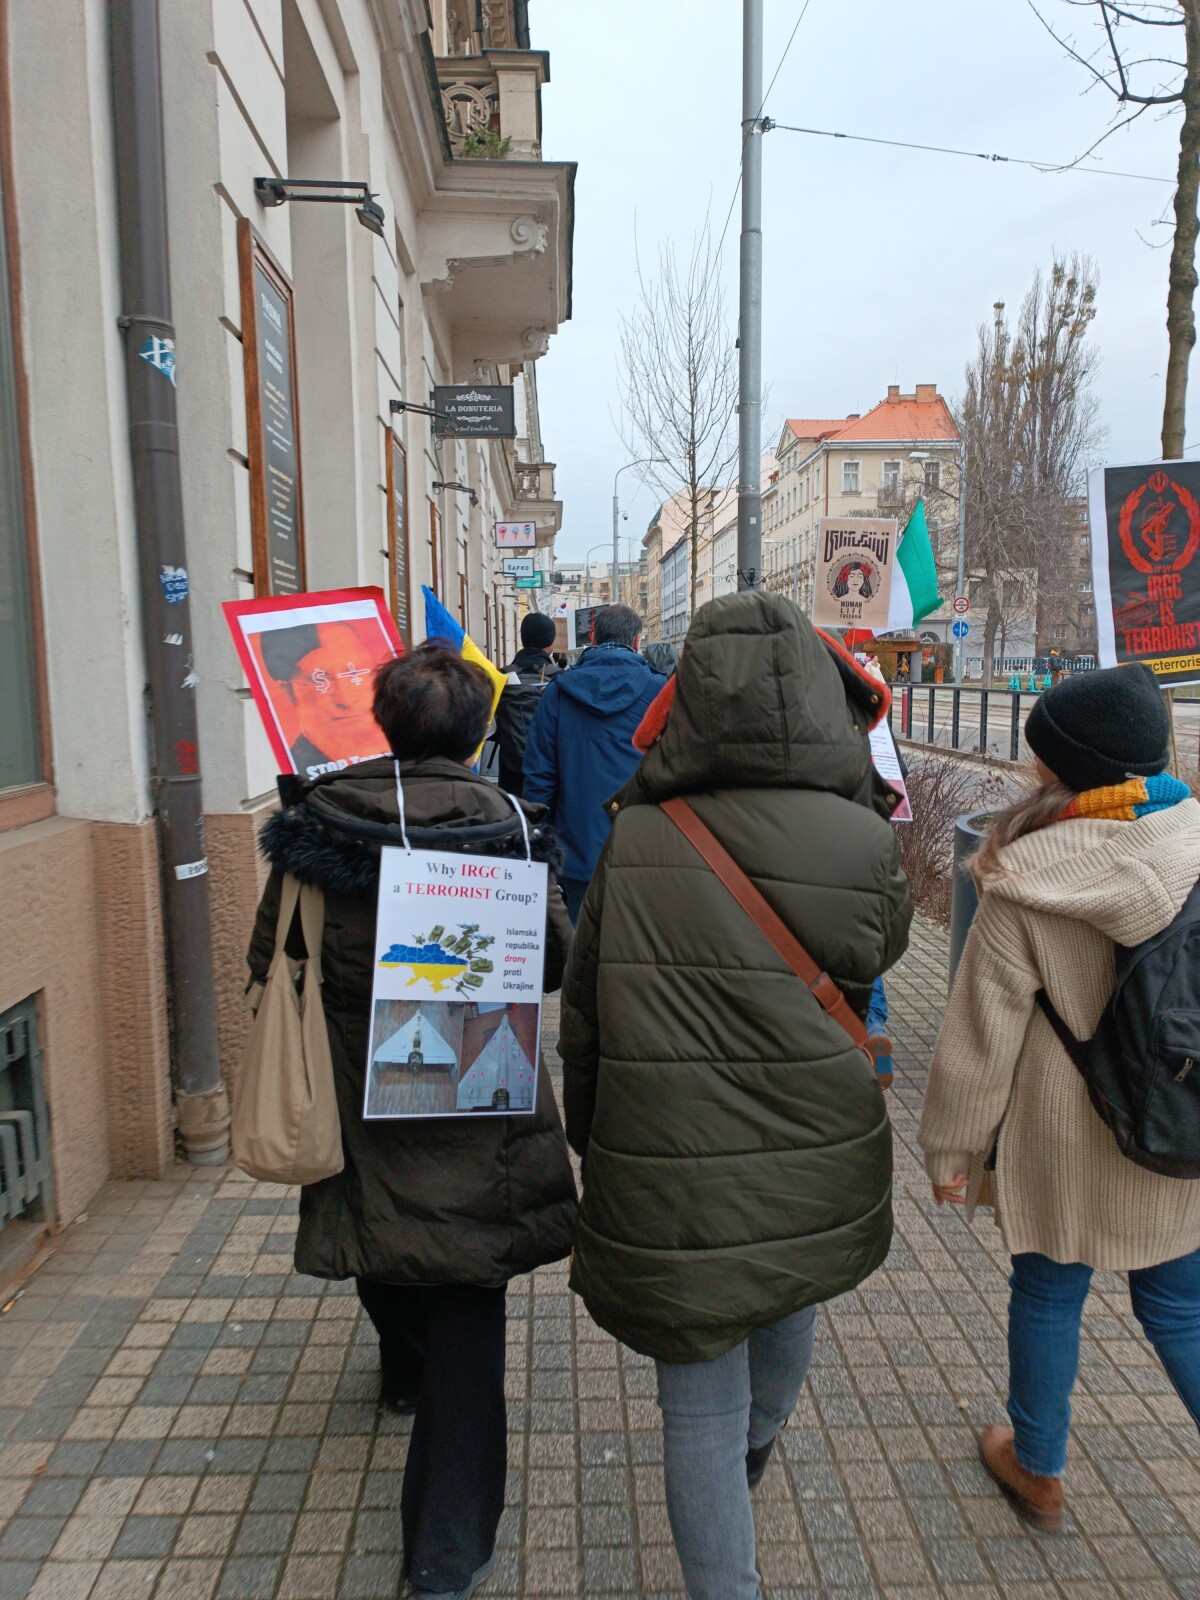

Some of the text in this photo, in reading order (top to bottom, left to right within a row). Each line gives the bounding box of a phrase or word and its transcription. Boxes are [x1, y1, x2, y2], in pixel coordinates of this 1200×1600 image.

[1147, 573, 1183, 602] IRGC
[1160, 600, 1175, 627] IS
[1152, 656, 1200, 672] cterroris
[426, 862, 513, 880] Why IRGC is
[393, 882, 538, 905] a TERRORIST Group?
[505, 942, 540, 950] republika
[504, 954, 526, 964] drony
[503, 968, 522, 977] proti
